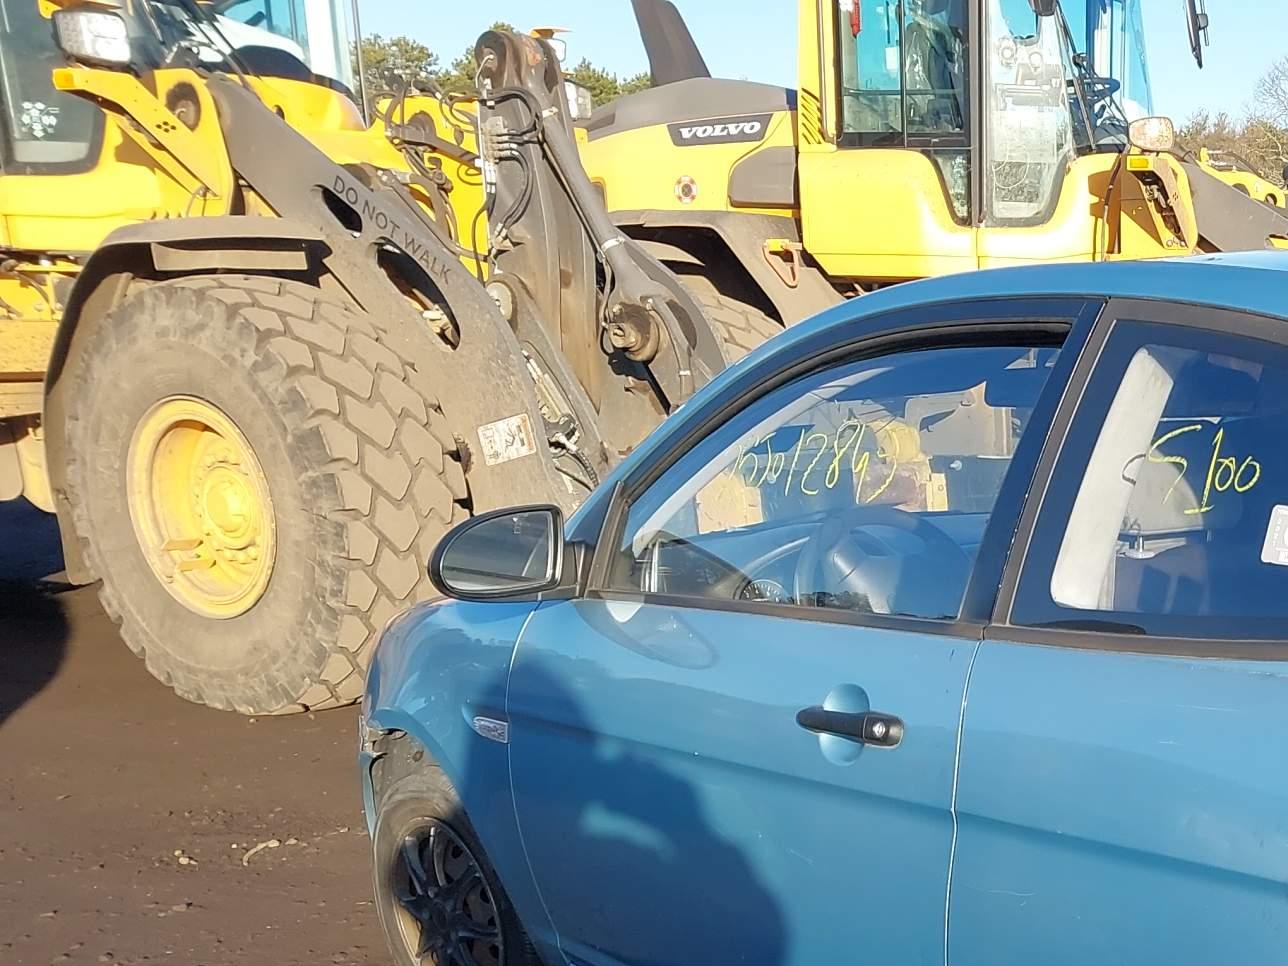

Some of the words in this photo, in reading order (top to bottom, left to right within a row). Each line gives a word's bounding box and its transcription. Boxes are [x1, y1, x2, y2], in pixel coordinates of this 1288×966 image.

[679, 121, 761, 139] VOLVO
[333, 175, 358, 205] DO
[362, 200, 400, 239] NOT
[404, 232, 451, 285] WALK
